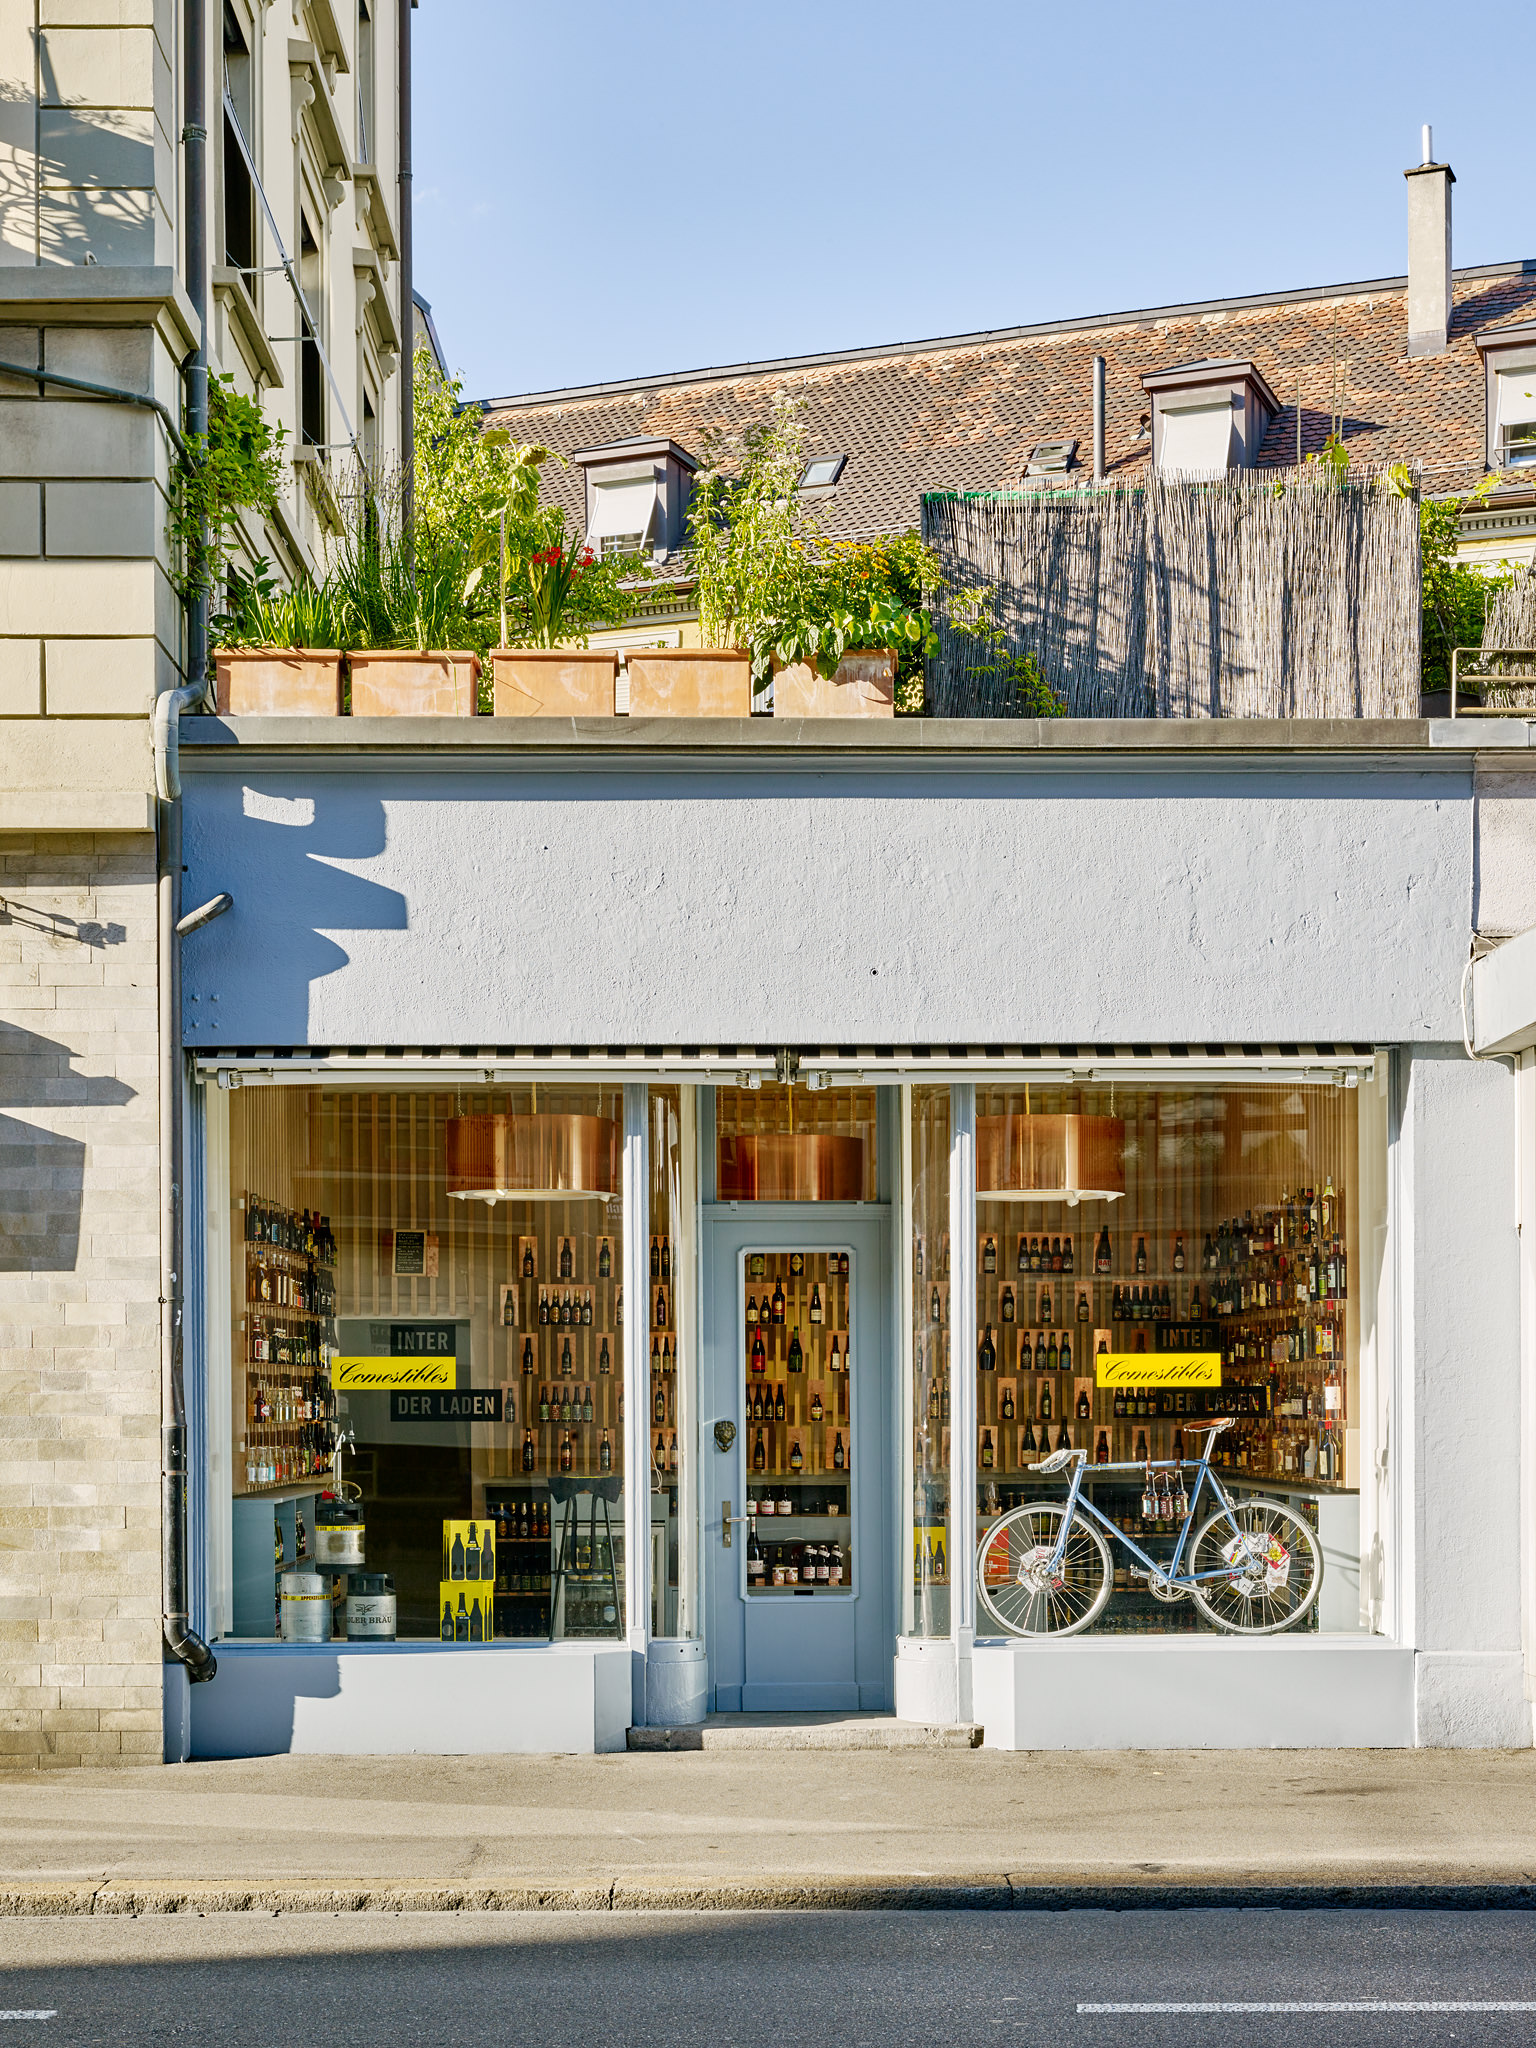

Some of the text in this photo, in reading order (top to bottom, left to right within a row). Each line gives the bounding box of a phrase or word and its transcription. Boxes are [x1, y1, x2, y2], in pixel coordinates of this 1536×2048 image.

[397, 1331, 448, 1350] INTER
[1162, 1328, 1213, 1347] INTER
[339, 1362, 448, 1384] Comestibles
[1104, 1359, 1213, 1381] Comestibles
[398, 1396, 495, 1415] DER LADEN
[1163, 1392, 1260, 1412] DER LADEN
[368, 1615, 392, 1624] BRÄU
